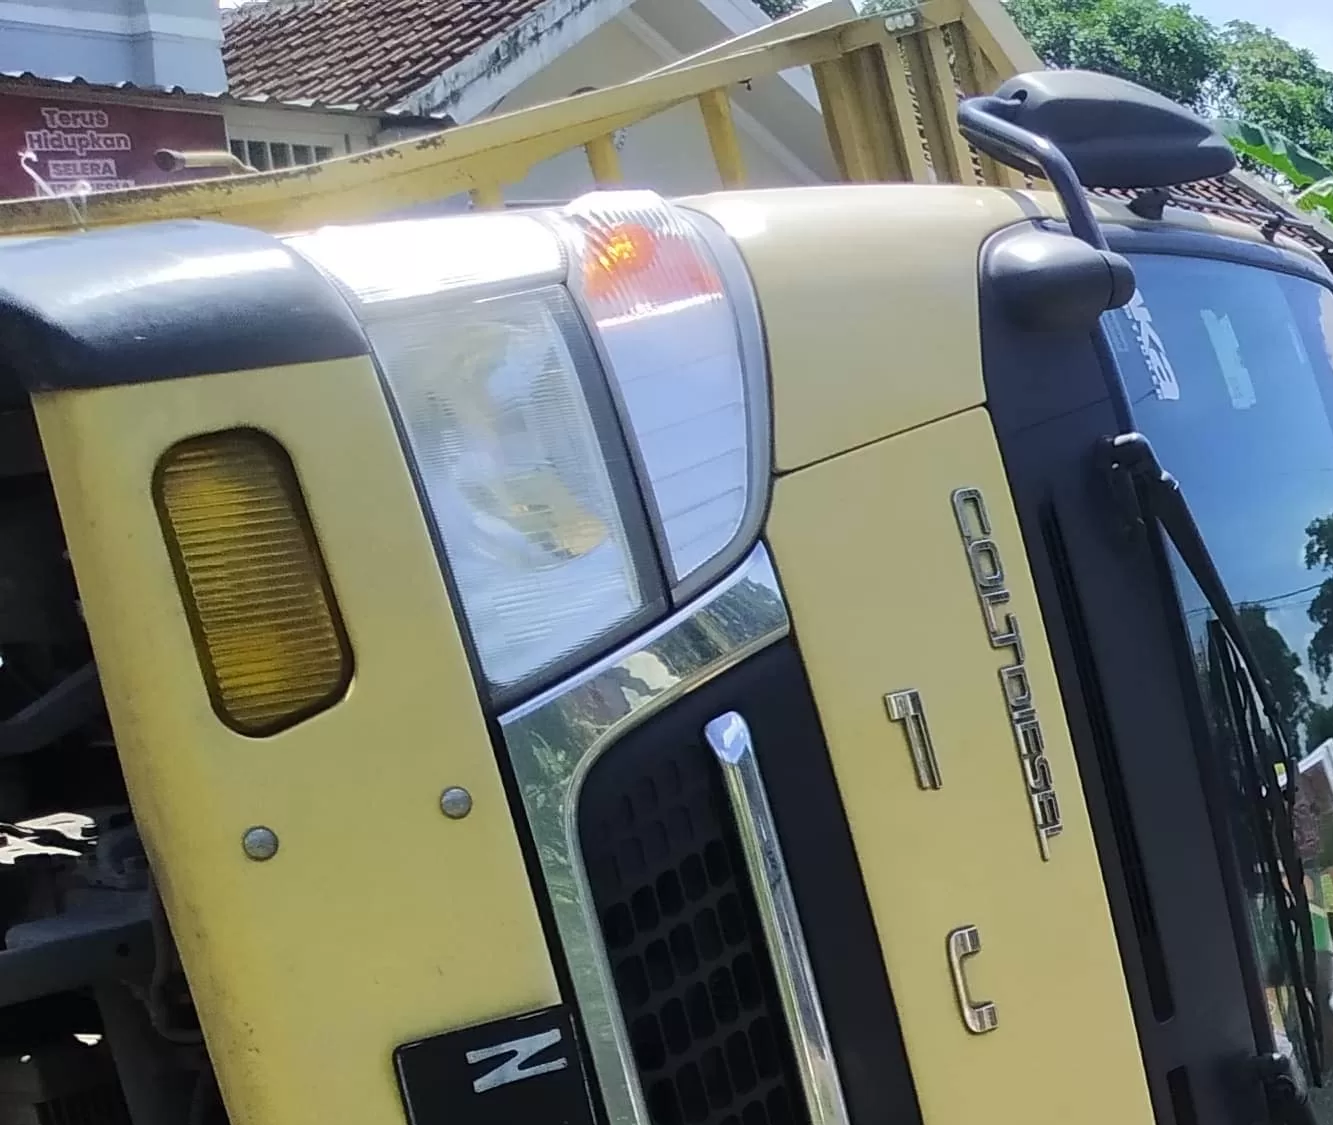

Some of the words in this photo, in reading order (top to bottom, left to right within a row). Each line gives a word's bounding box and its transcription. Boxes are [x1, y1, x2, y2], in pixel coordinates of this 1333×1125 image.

[41, 107, 108, 128] Terus
[25, 130, 131, 156] Hidupkan
[52, 162, 112, 176] SELERA
[950, 487, 1024, 665] COLT
[999, 664, 1064, 863] DIESEL
[465, 1028, 568, 1093] N
